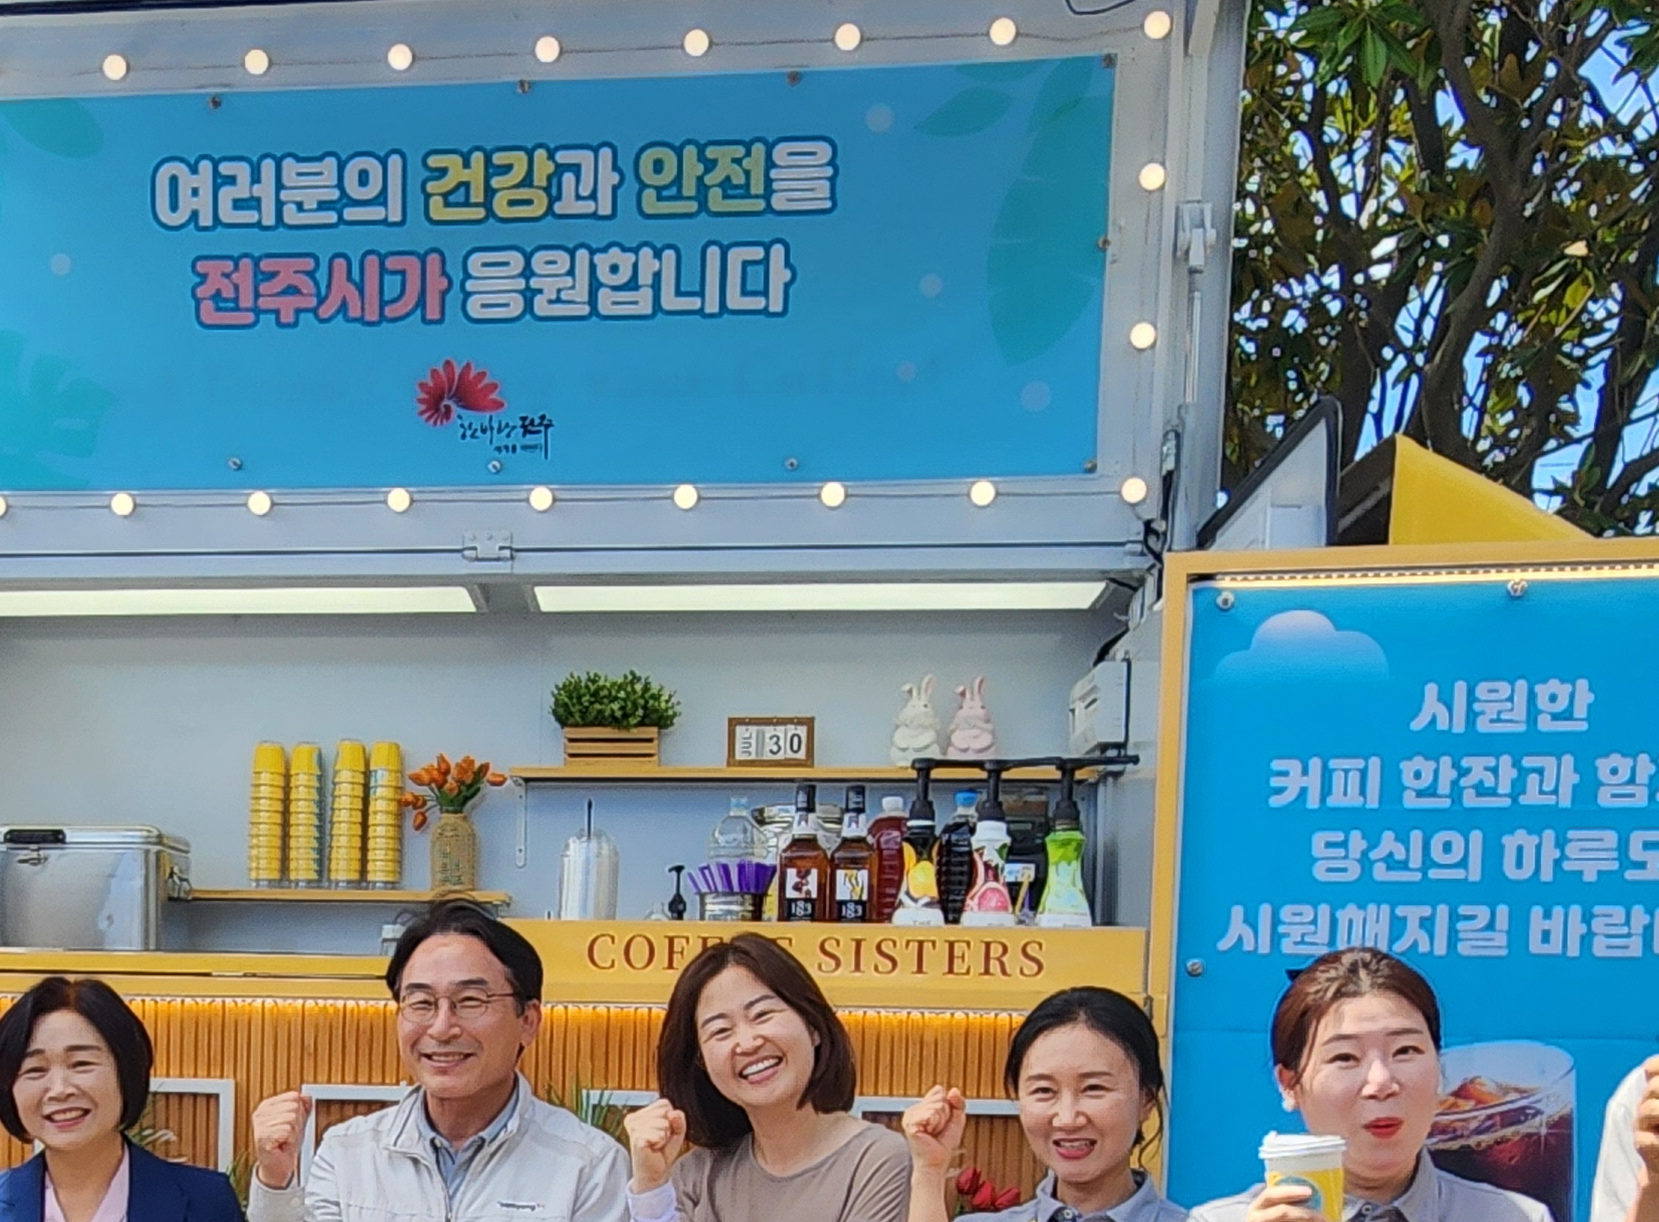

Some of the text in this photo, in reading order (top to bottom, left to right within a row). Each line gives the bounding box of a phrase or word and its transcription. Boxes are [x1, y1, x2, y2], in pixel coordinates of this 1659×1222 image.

[153, 139, 836, 229] 여러분의 건강과 안전을
[194, 241, 794, 326] 전주시가 응원합니다
[1409, 678, 1595, 734] 시원한
[768, 733, 802, 756] 30
[1267, 752, 1659, 809] 커피 한잔과 함
[1310, 828, 1484, 882] 당신의
[586, 932, 1046, 978] COF SISTERS
[1216, 902, 1659, 958] 시원해지길 바랍
